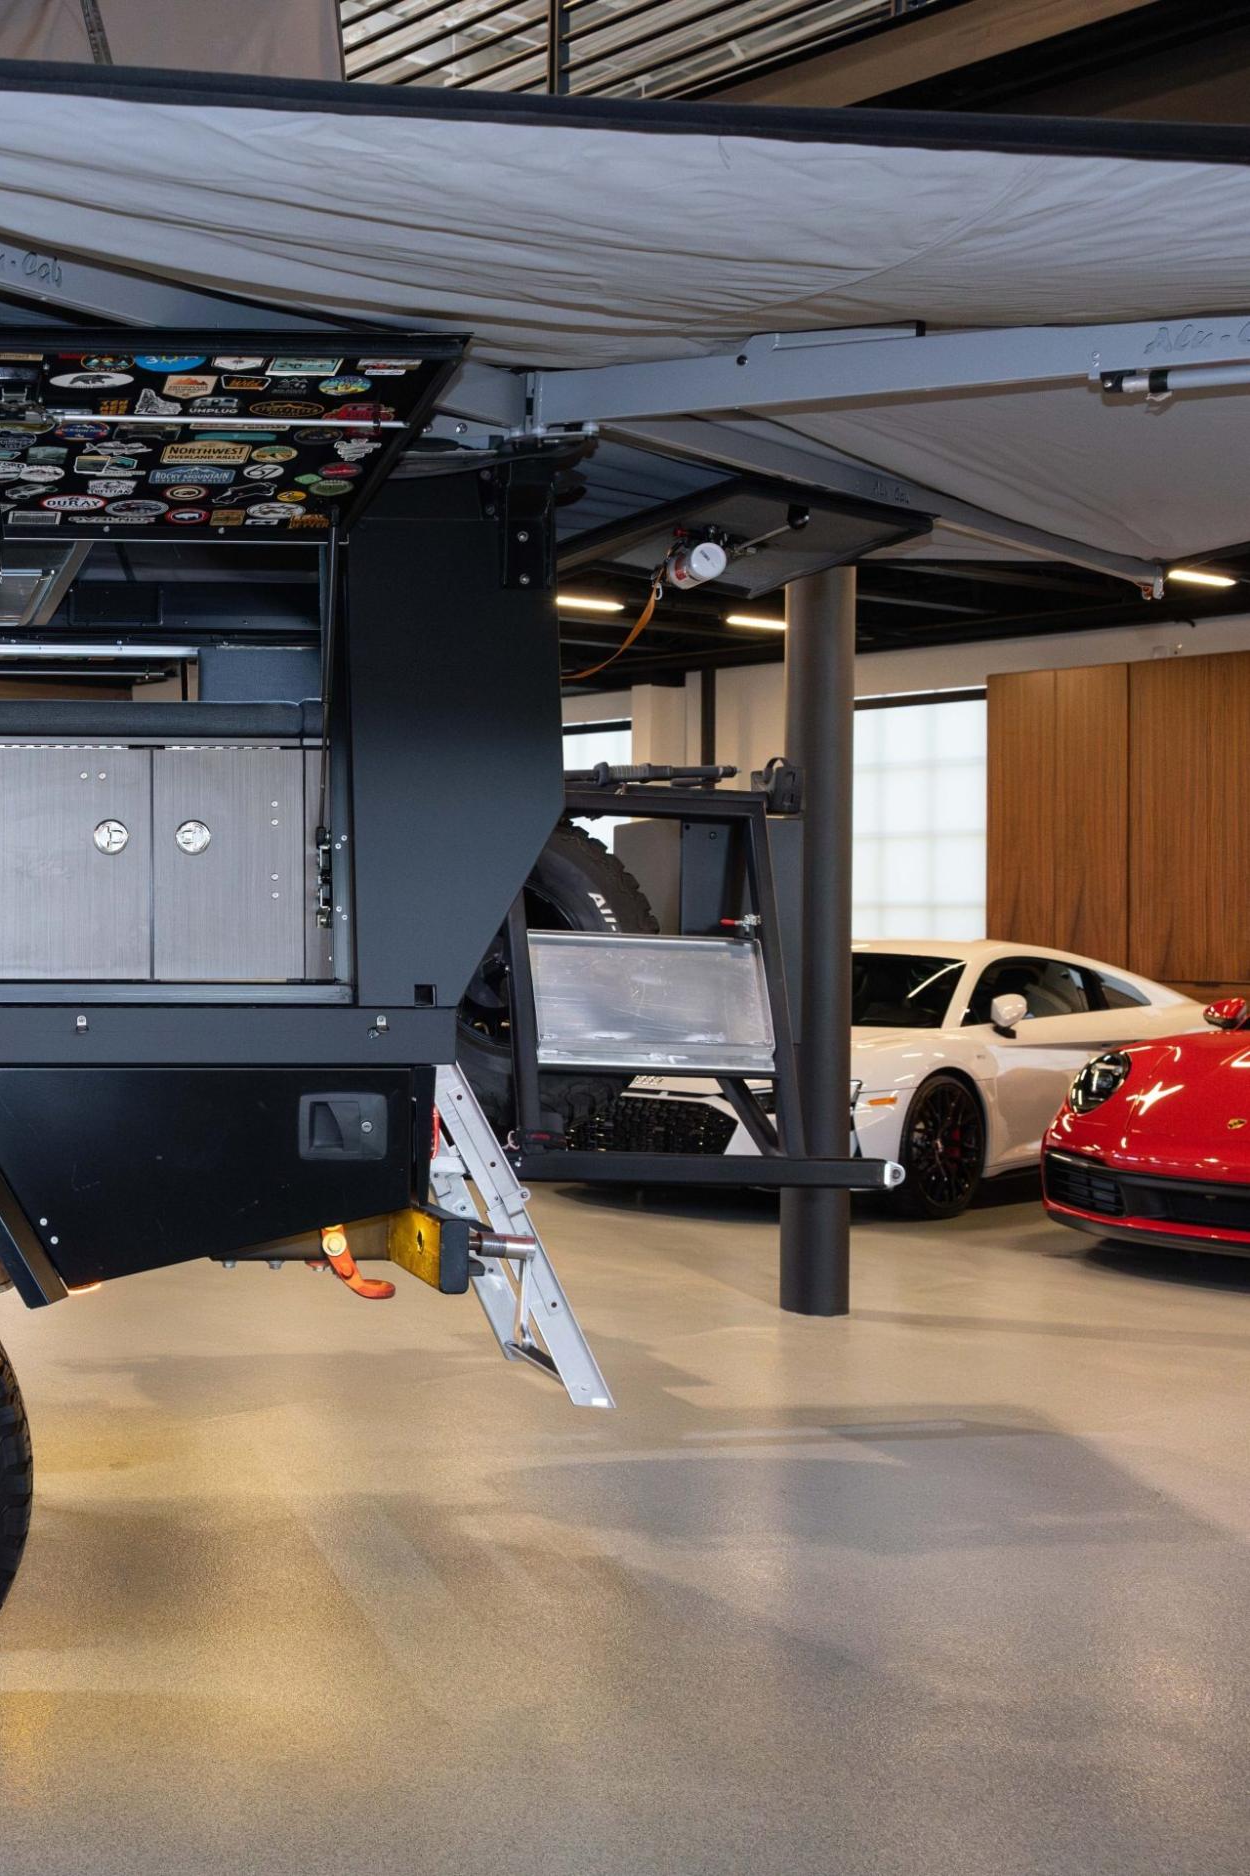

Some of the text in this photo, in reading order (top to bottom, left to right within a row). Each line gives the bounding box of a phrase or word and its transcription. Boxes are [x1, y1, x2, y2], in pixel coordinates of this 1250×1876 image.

[169, 446, 245, 455] NORTHWEST
[155, 471, 229, 481] ROCKY MOUNTAIN
